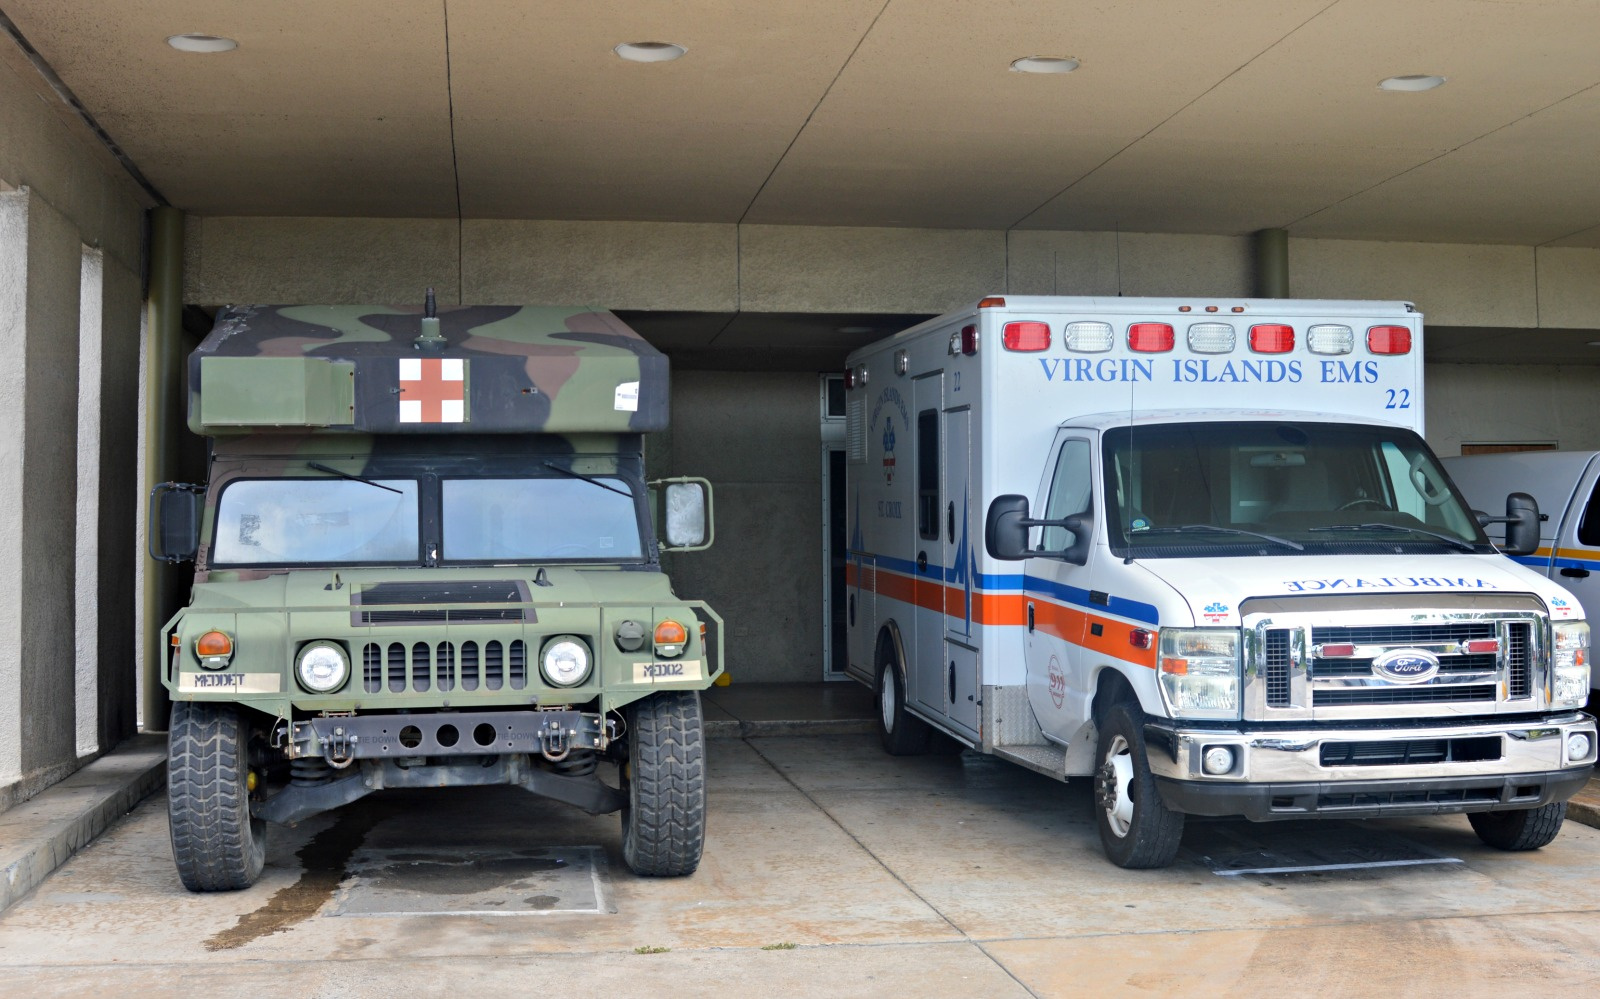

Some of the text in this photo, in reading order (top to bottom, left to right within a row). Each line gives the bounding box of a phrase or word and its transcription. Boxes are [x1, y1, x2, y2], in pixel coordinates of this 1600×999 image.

[1039, 358, 1379, 384] VIRGIN ISLANDS EMS
[954, 371, 961, 392] 22
[1385, 388, 1411, 409] 22
[1394, 658, 1423, 672] Ford
[1050, 672, 1065, 690] 911
[510, 732, 537, 740] DOWN
